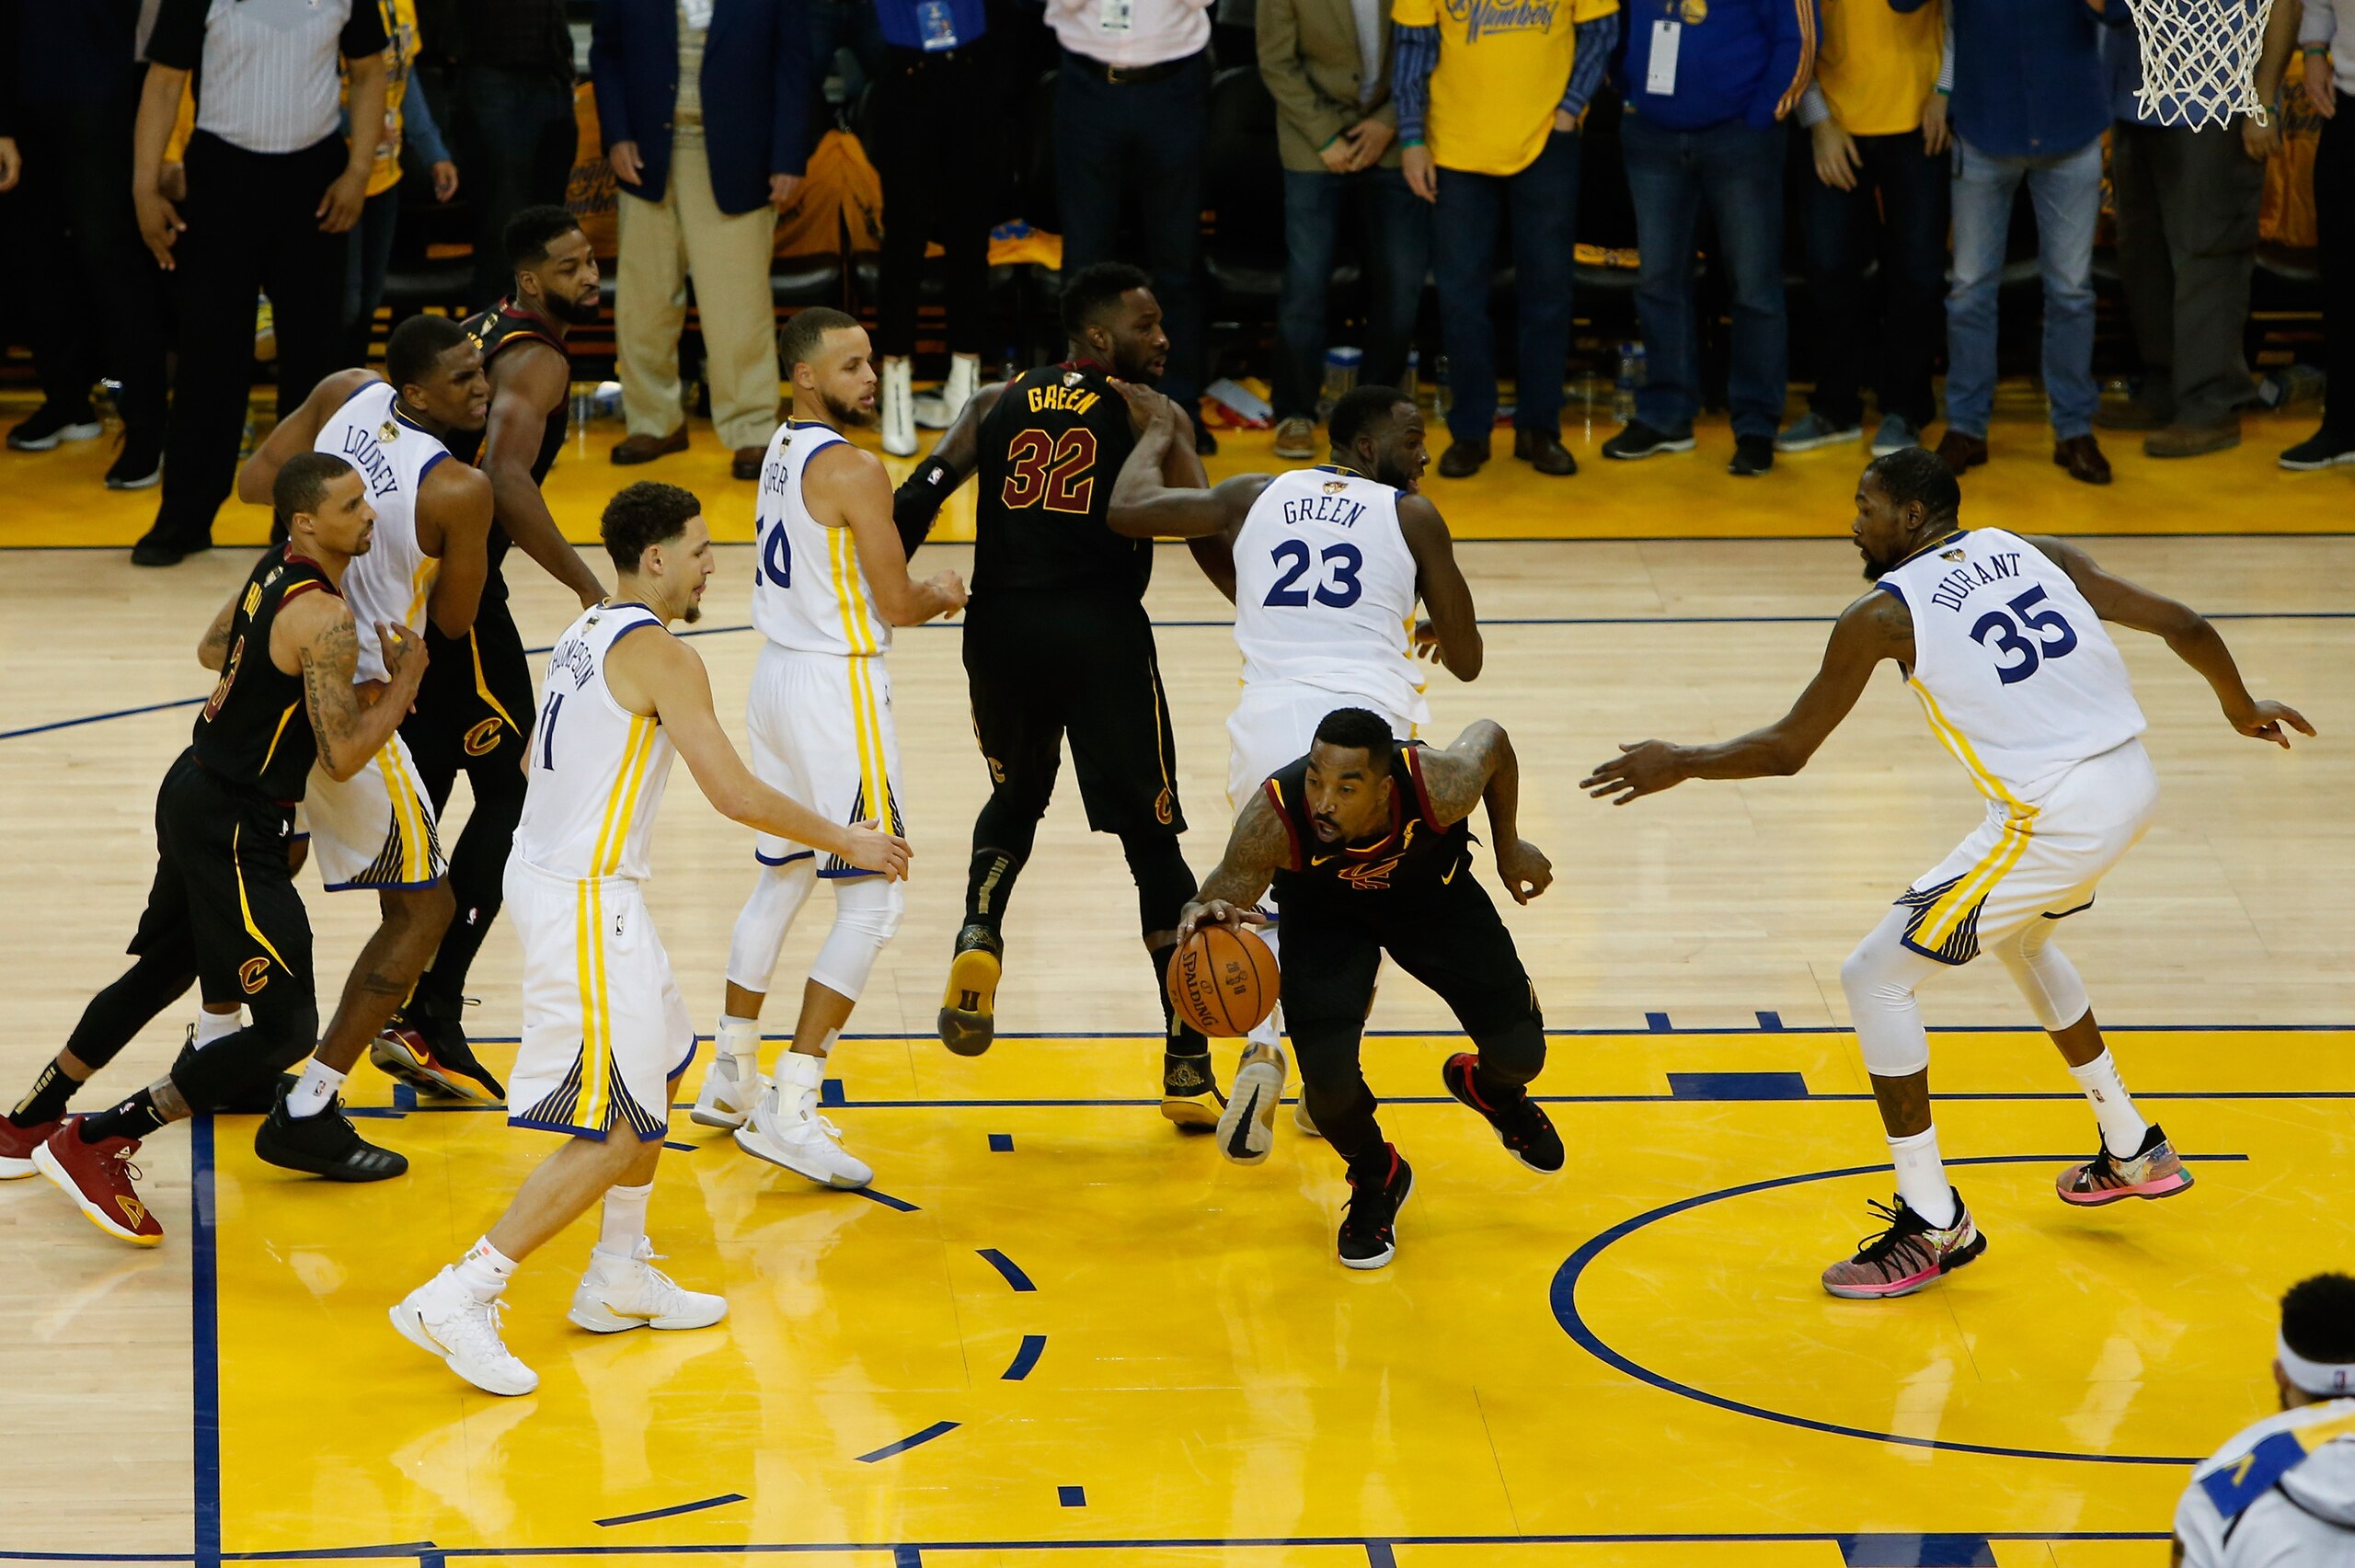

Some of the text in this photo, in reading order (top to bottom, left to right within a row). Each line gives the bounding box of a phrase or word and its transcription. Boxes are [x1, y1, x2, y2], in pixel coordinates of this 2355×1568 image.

[1028, 383, 1101, 415] GREEN
[343, 425, 398, 498] LOONEY
[1001, 428, 1097, 514] 32
[1283, 496, 1367, 529] GREEN
[1262, 539, 1363, 609] 23
[1931, 553, 2021, 613] DURANT
[1969, 581, 2078, 686] 35
[203, 634, 245, 724] 3
[534, 691, 565, 771] 11
[1183, 950, 1219, 1027] SPALDING
